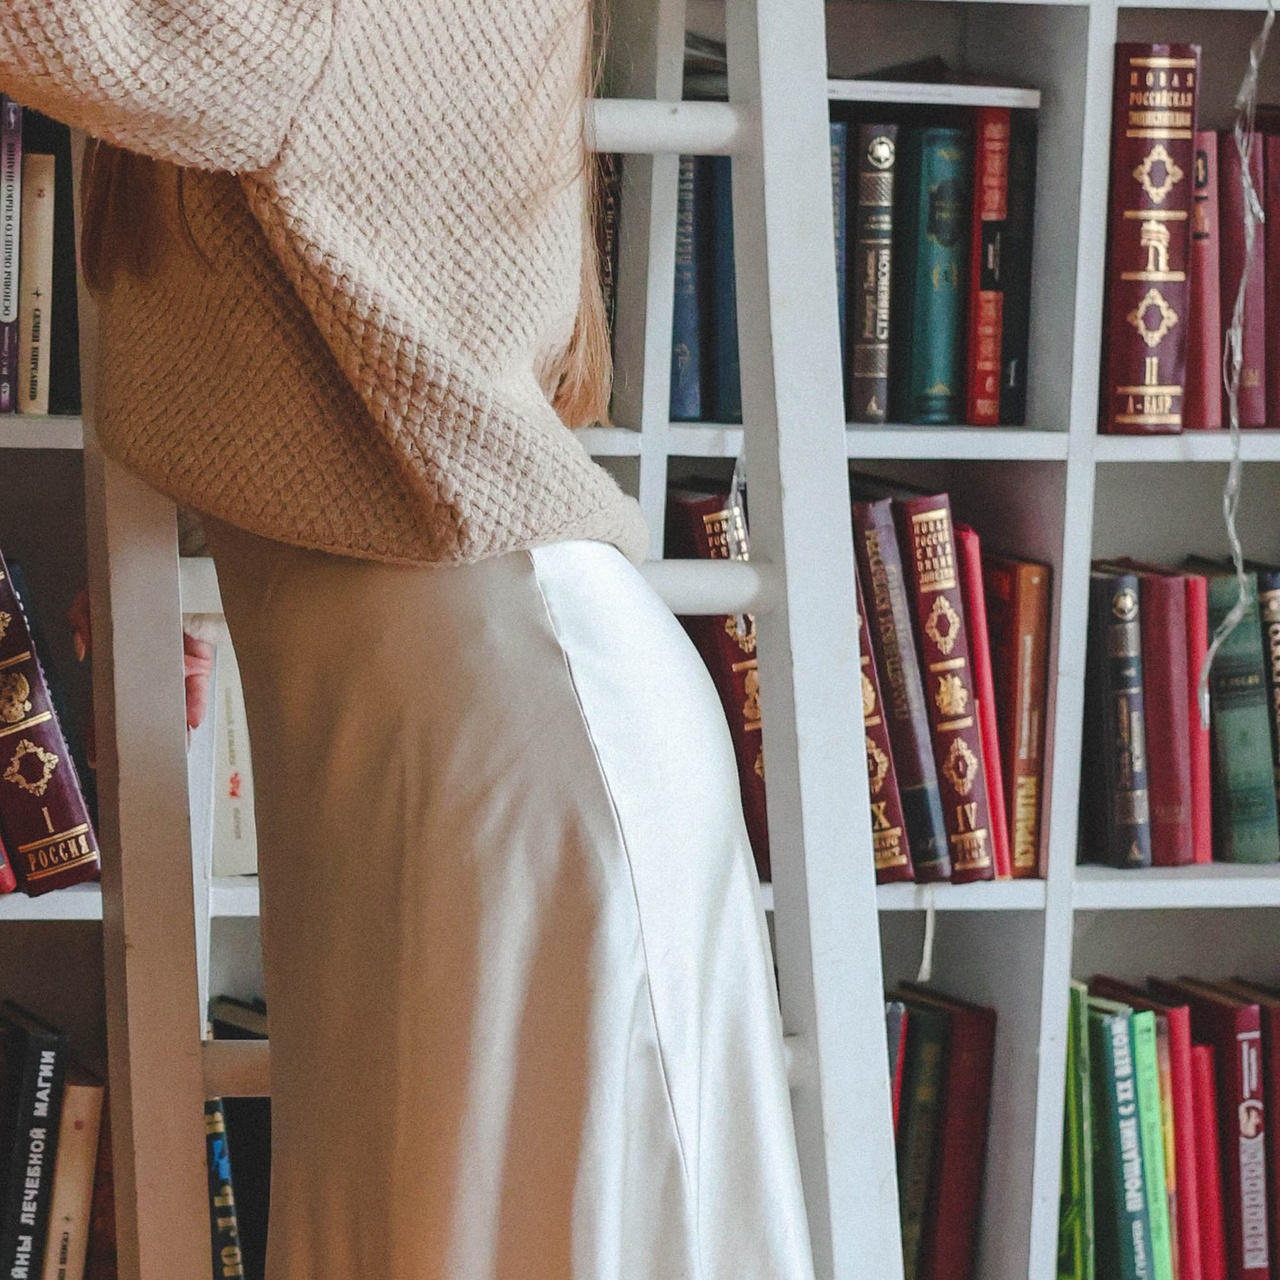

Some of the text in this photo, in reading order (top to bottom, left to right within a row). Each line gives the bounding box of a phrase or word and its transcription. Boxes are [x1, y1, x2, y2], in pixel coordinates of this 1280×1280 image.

[1129, 70, 1195, 88] НОВАЯ
[1129, 90, 1194, 108] РОССИЙСКАЯ
[3, 223, 13, 267] ОБЩЕГО
[2, 271, 12, 317] ОСНОВЫ
[26, 346, 42, 401] КИРСАНОВ
[912, 518, 949, 536] НОВАЯ
[913, 529, 951, 548] РОССИЙ
[914, 542, 953, 561] СКАЯ
[955, 801, 978, 833] IV
[27, 833, 90, 872] РОССИЯ
[31, 1048, 56, 1117] МАГИИ
[17, 1125, 47, 1225] ЛЕЧЕБНОЙ
[1118, 1116, 1145, 1212] ПРОЩАНИЕ
